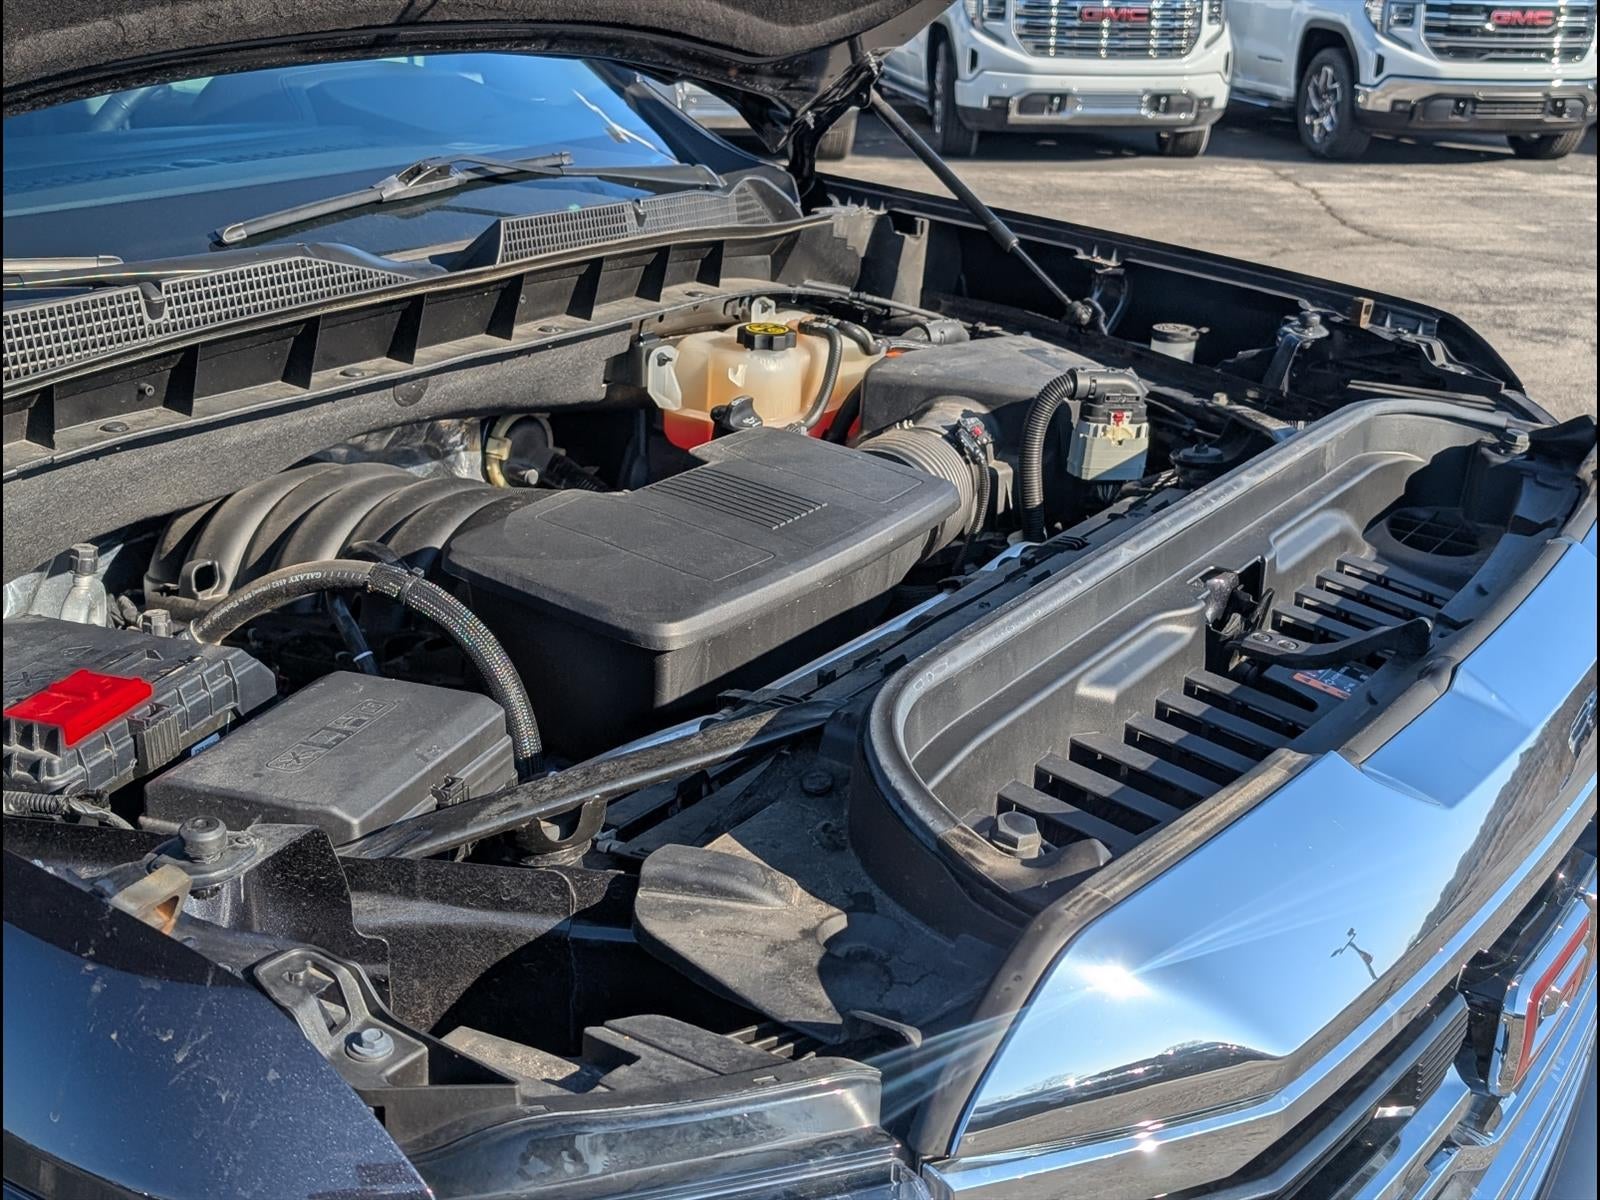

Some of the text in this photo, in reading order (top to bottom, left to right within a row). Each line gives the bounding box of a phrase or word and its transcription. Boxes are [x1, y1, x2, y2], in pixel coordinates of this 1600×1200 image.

[1081, 6, 1150, 22] GMC
[1490, 10, 1555, 25] GMC
[289, 572, 322, 583] GALAXY
